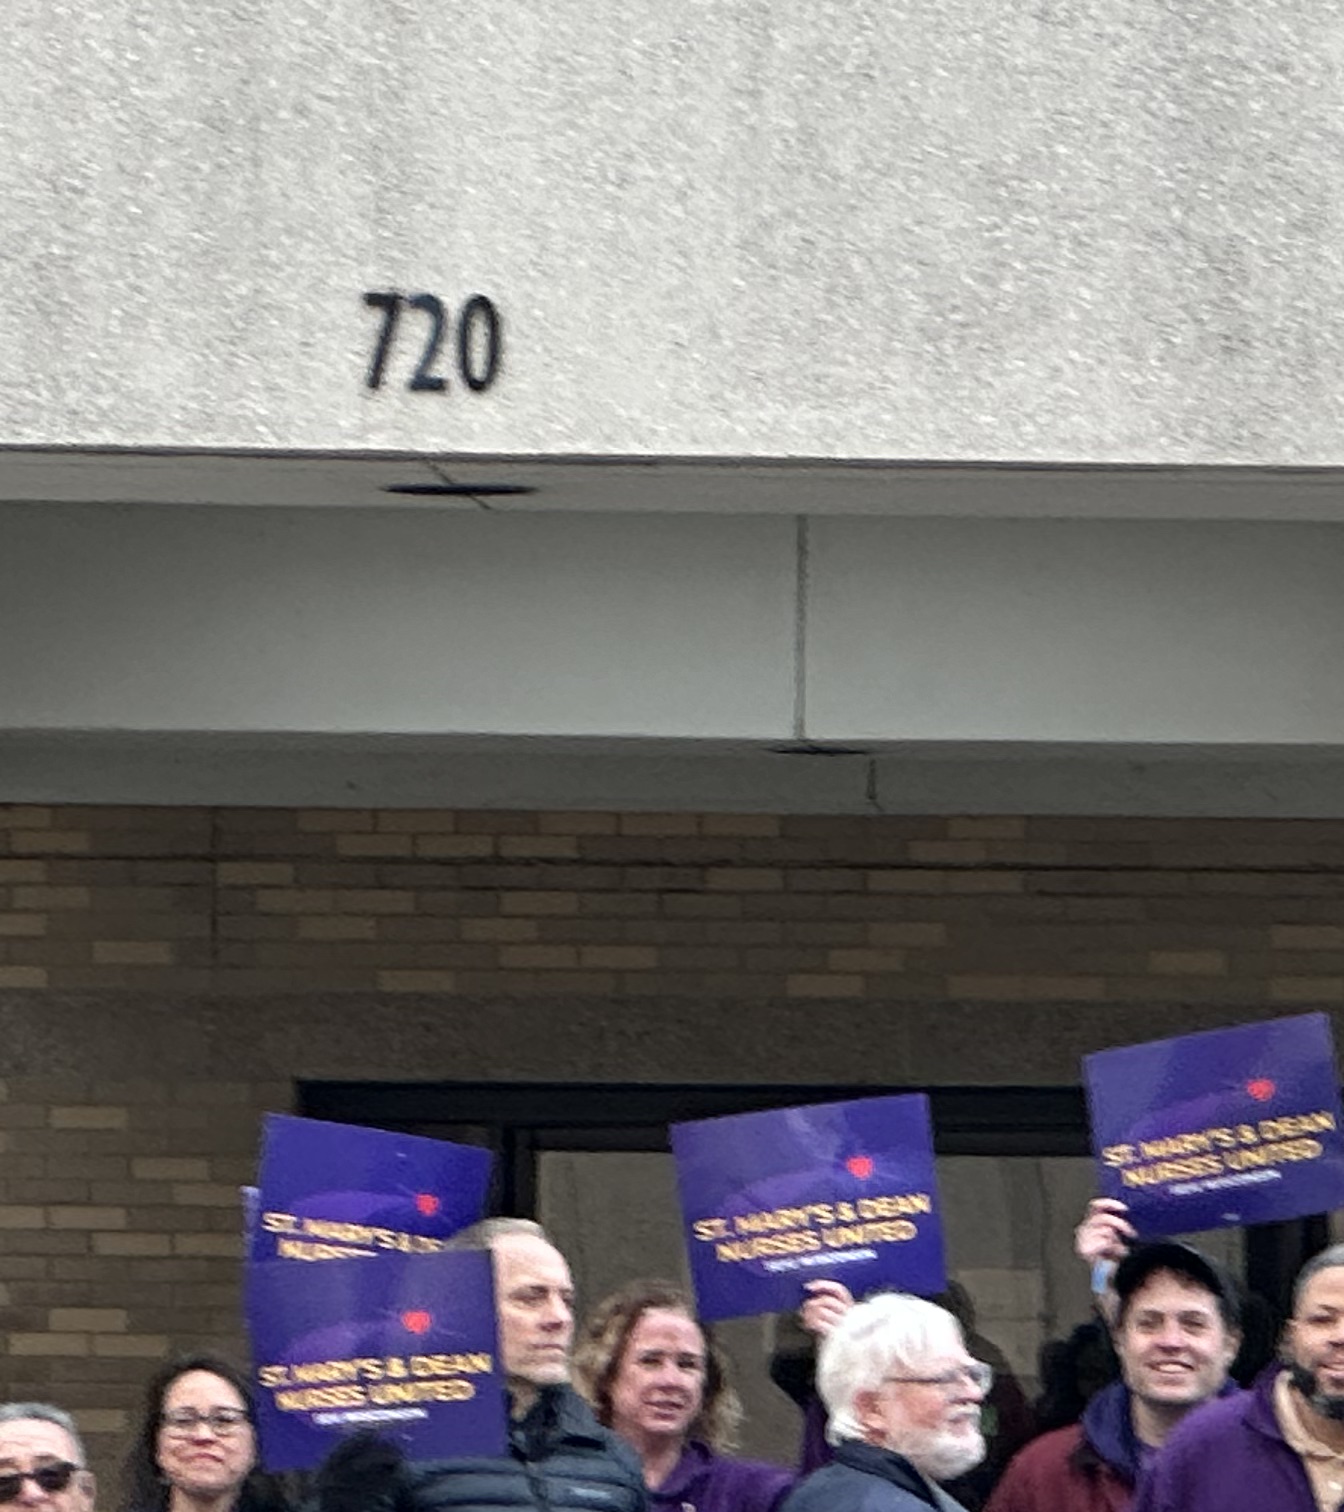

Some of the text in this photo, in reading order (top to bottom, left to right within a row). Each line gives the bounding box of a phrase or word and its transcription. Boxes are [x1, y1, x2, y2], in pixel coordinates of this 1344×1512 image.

[362, 292, 501, 390] 720
[1236, 1123, 1258, 1145] &
[1258, 1110, 1336, 1140] DEAN
[1122, 1154, 1224, 1188] NURSES
[1223, 1138, 1323, 1171] UNITED
[836, 1201, 858, 1222] &
[857, 1193, 931, 1219] DEAN
[716, 1230, 821, 1263] NURSES
[821, 1219, 918, 1248] UNITED
[386, 1356, 408, 1378] &
